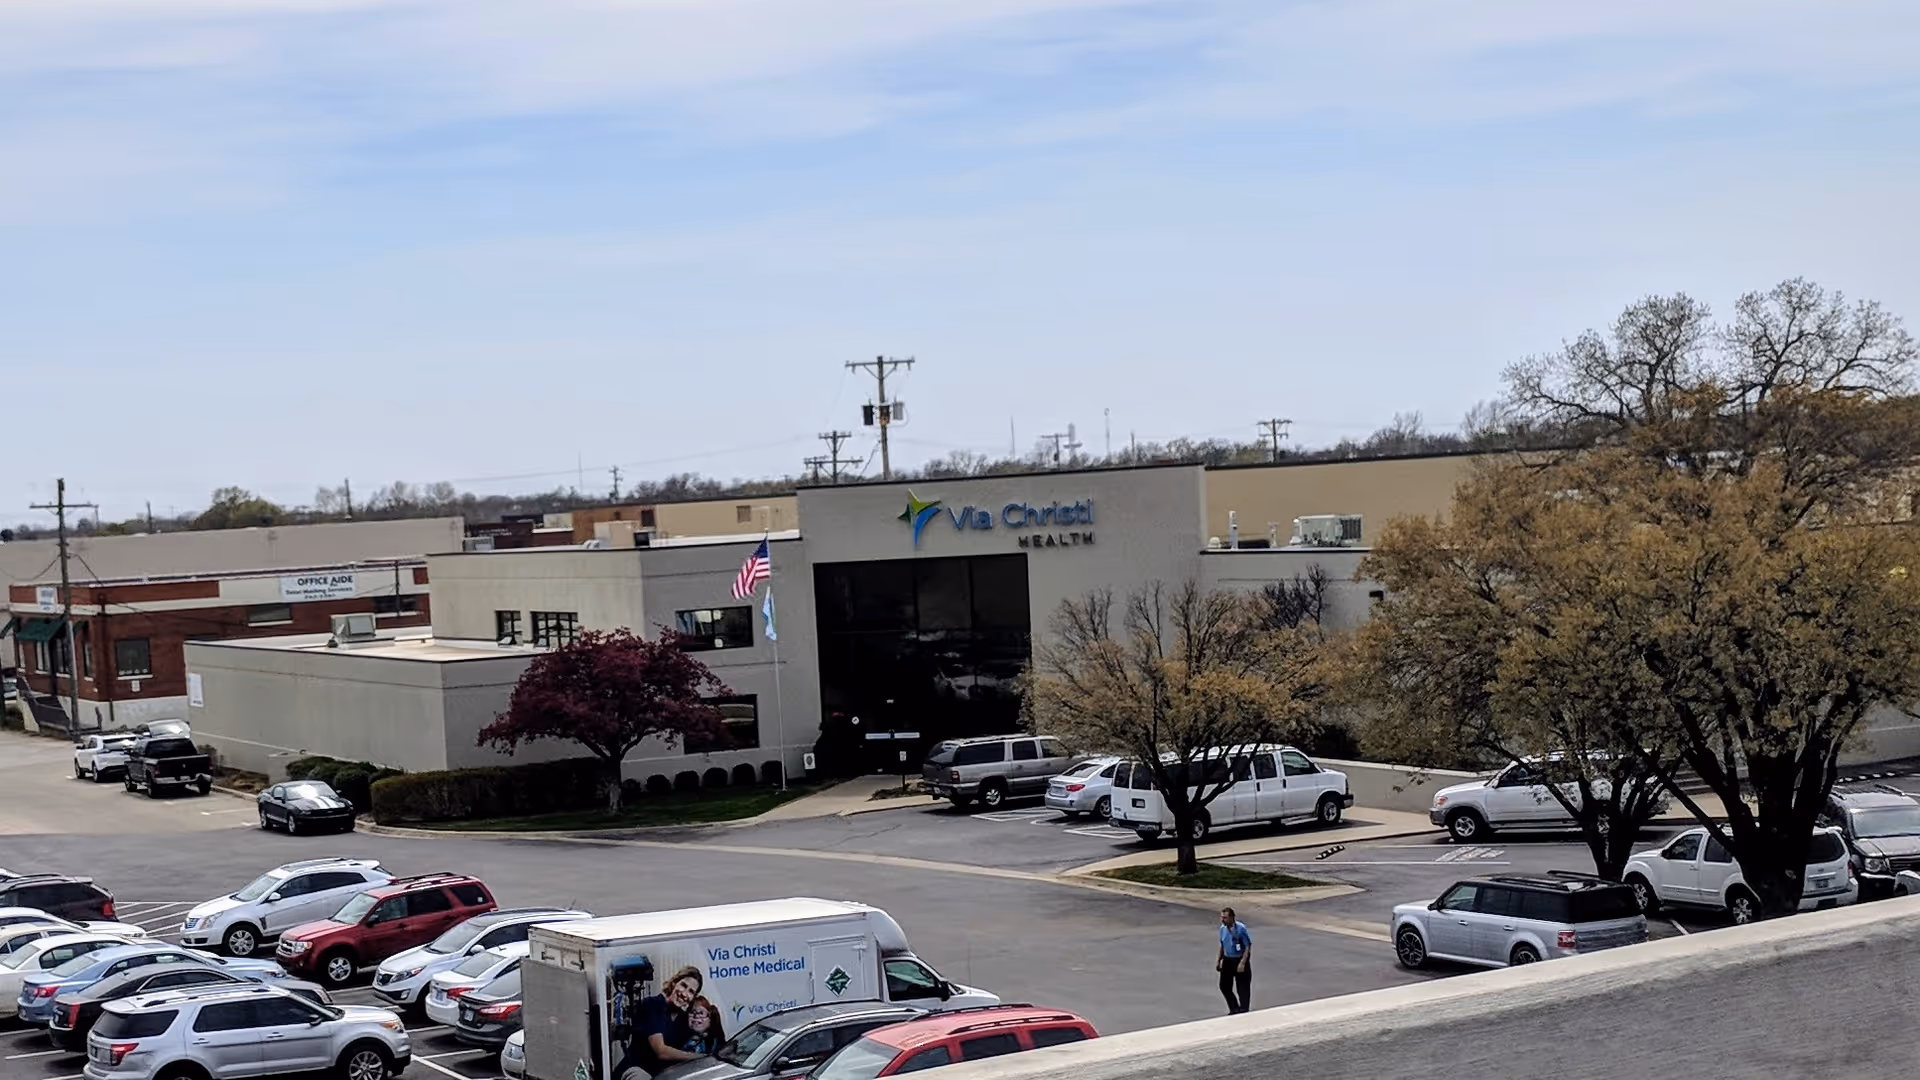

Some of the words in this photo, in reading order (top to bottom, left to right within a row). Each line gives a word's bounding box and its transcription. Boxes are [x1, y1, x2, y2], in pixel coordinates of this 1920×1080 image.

[948, 505, 993, 531] Via
[1002, 499, 1094, 528] Christi
[1018, 531, 1095, 548] HEALTH
[297, 576, 328, 586] OFFICE
[331, 575, 353, 584] AIDE
[708, 948, 730, 961] Via
[733, 941, 776, 958] Christi
[709, 966, 749, 979] Home
[753, 956, 805, 974] Medical
[748, 1004, 763, 1014] Via
[766, 999, 797, 1012] Christi
